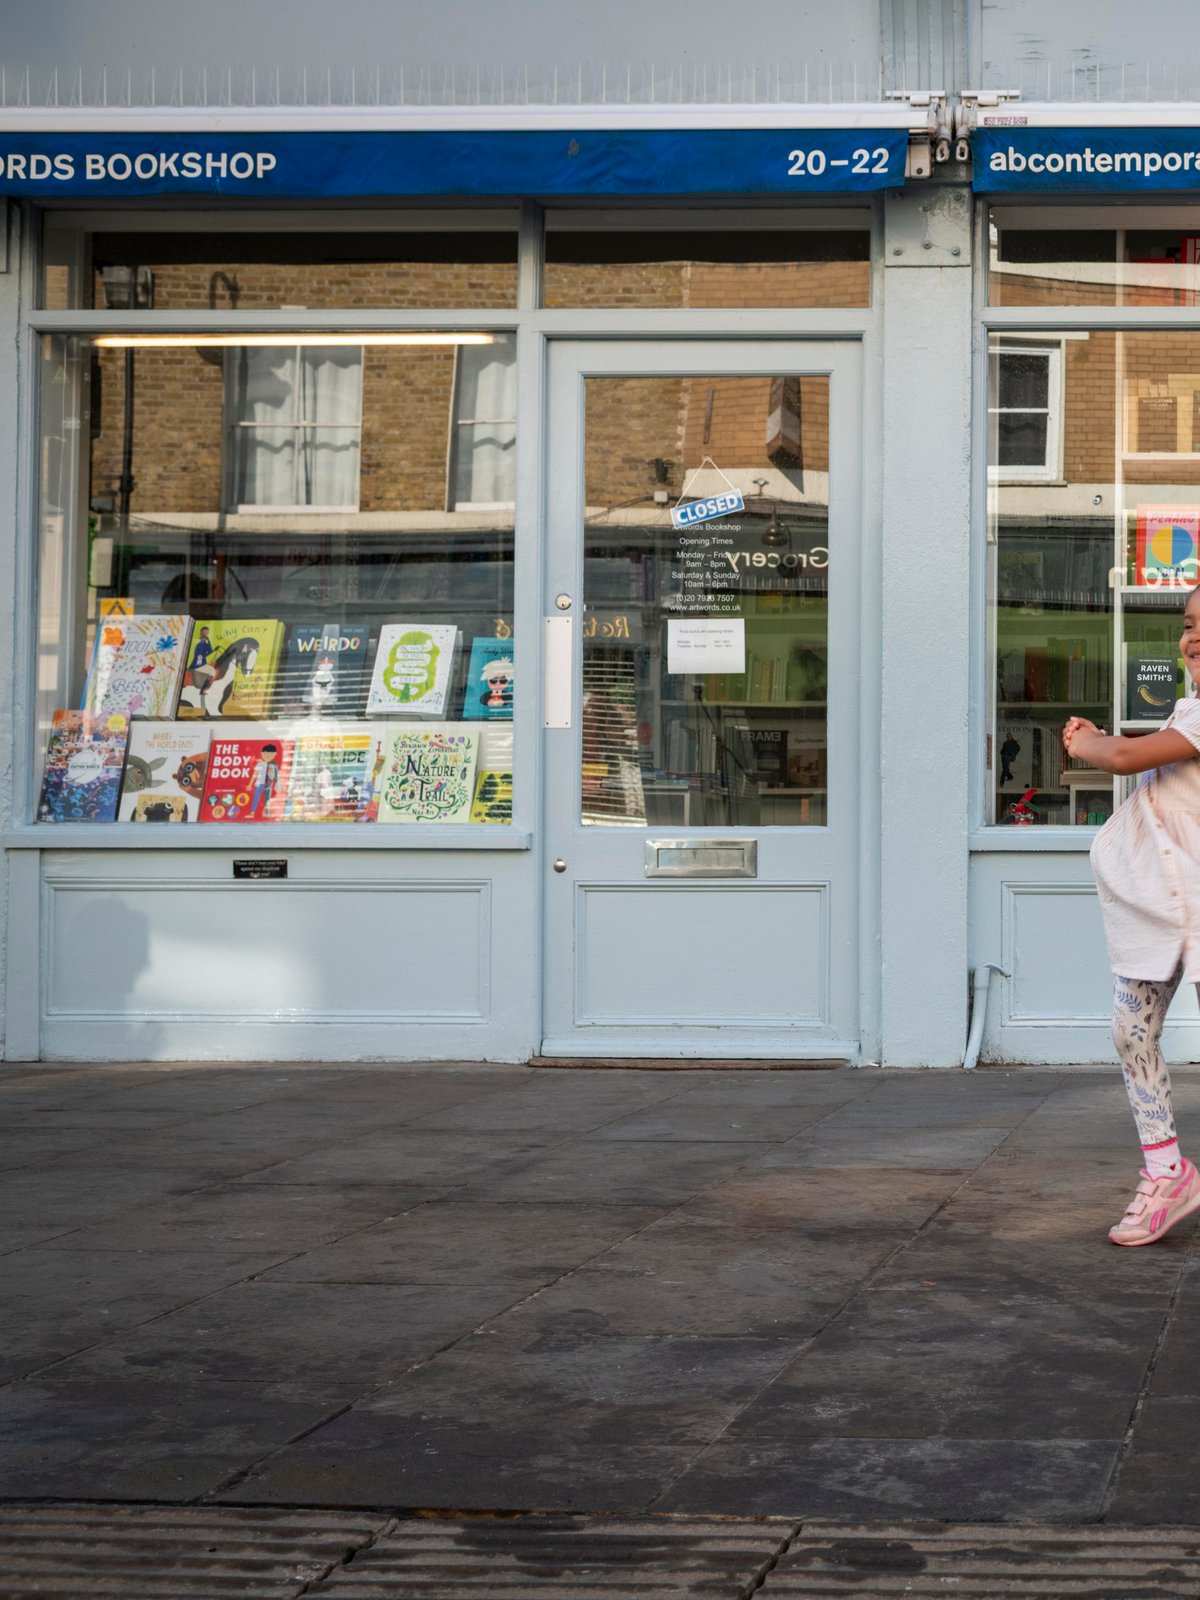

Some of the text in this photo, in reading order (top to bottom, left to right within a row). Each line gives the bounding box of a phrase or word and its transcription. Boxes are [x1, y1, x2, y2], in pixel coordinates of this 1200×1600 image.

[85, 152, 277, 180] BOOKSHOP
[676, 494, 739, 523] CLOSED
[706, 523, 741, 532] Bookshop
[680, 537, 734, 546] Opening Times
[676, 551, 705, 560] Monday
[686, 560, 727, 569] 9am 8pm
[671, 571, 741, 581] Saturday & Sunday
[711, 581, 728, 589] 6pm
[296, 636, 361, 653] WEIRDO
[1140, 664, 1170, 673] RAVEN
[1136, 673, 1173, 682] SMITH'S
[215, 744, 240, 755] THE
[213, 755, 252, 767] BODY
[400, 754, 456, 777] NATURE
[211, 767, 250, 779] BOOK
[413, 779, 449, 802] TRAIL
